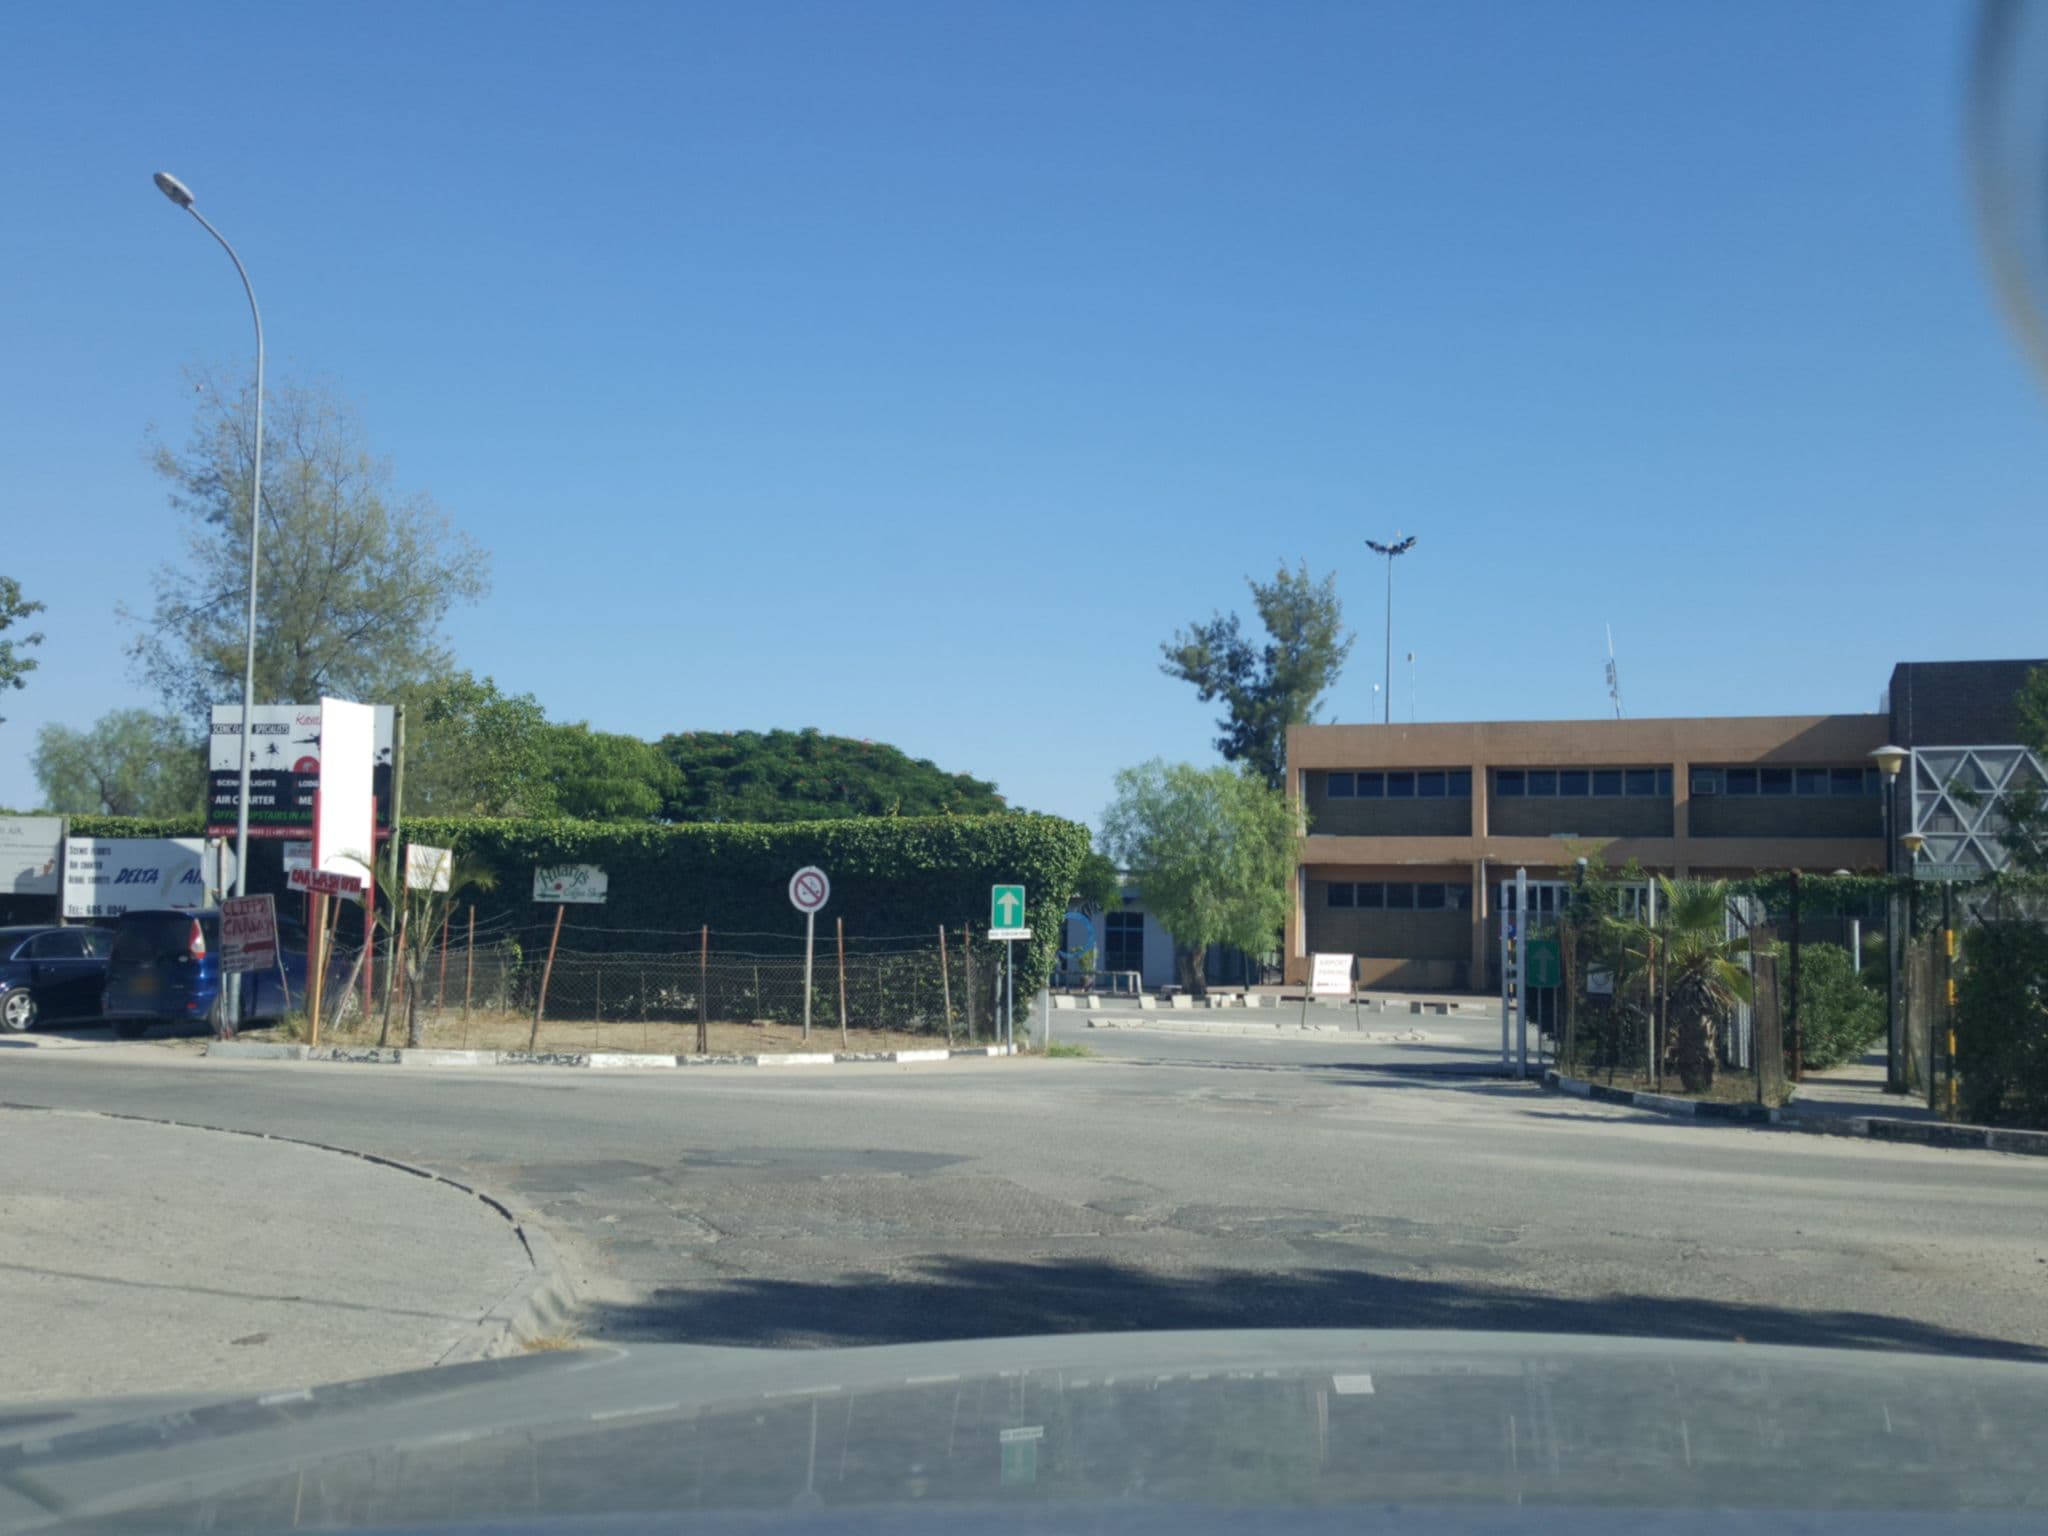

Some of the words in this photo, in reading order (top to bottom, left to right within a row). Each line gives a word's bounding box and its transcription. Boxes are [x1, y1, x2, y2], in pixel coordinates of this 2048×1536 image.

[216, 779, 241, 787] SCENI
[250, 779, 276, 787] LIGHTS
[215, 795, 231, 805] AIR
[232, 795, 275, 805] CARTER
[213, 811, 241, 820] OFFIC
[114, 868, 159, 884] DELTA
